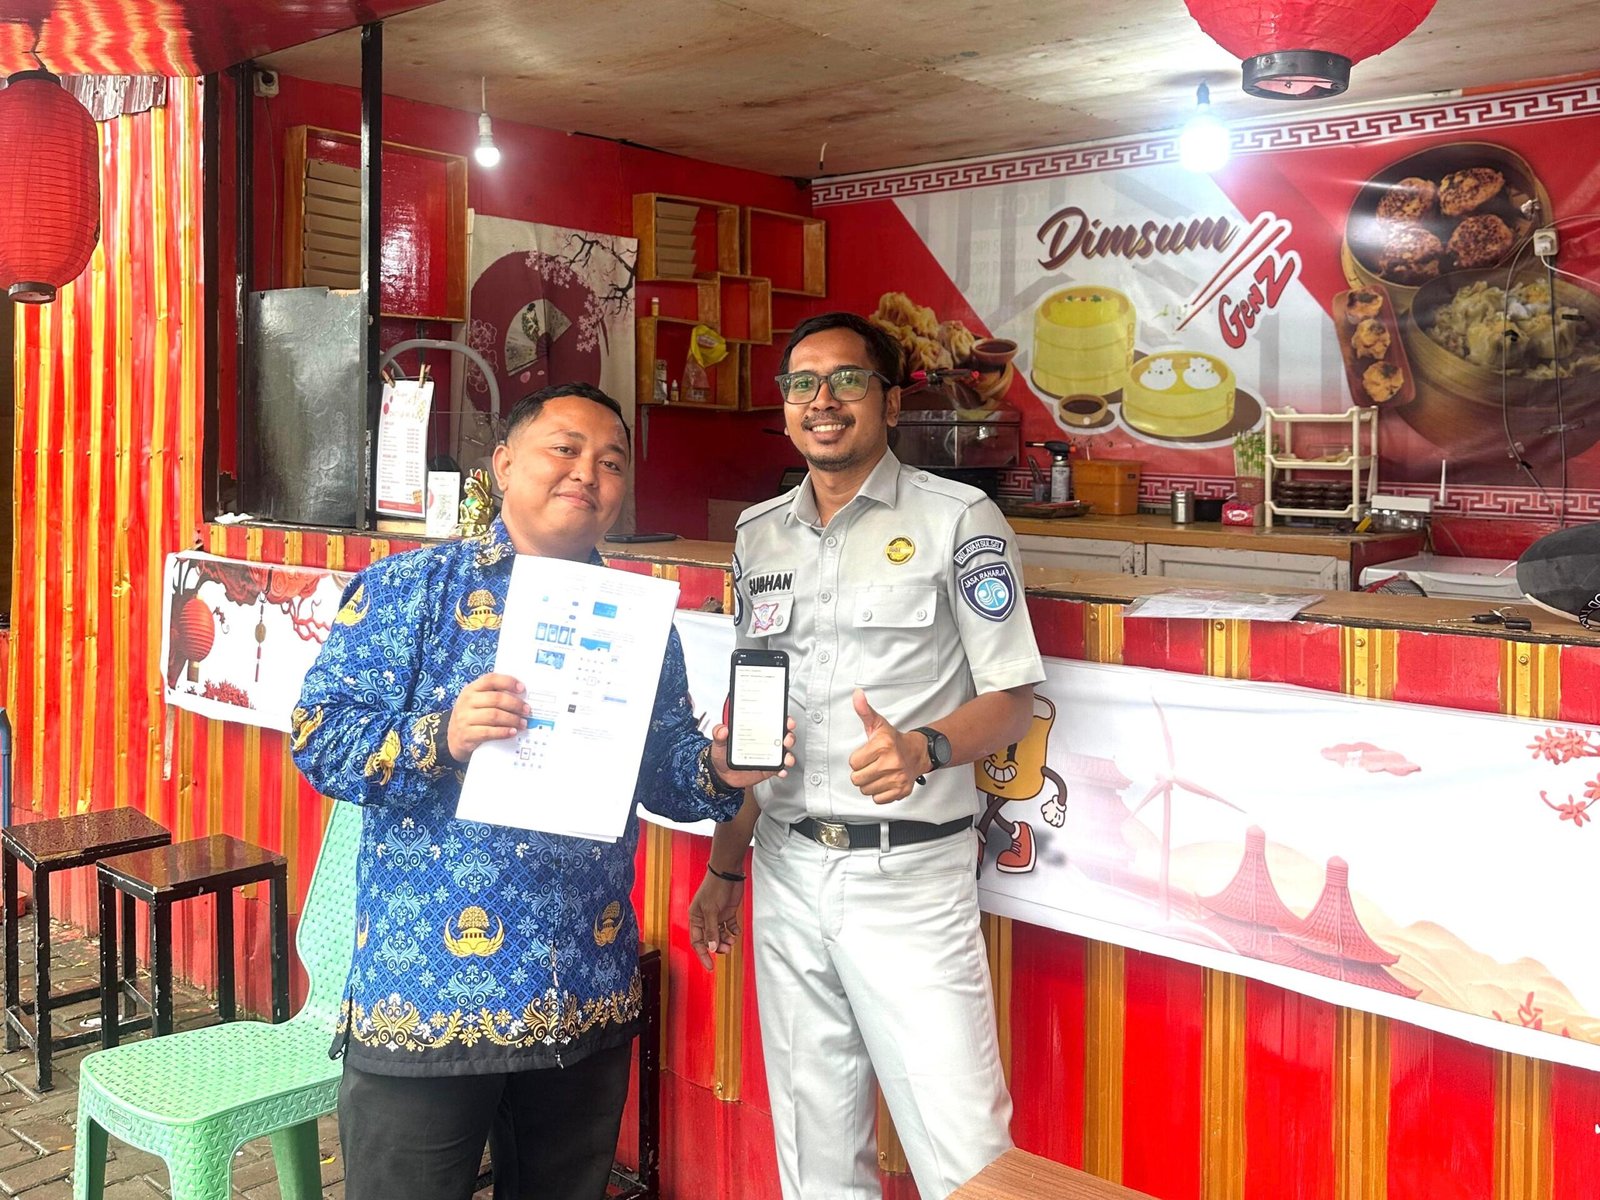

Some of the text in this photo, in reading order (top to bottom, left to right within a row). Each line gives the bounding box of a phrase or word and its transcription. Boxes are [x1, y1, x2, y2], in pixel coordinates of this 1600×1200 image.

[1037, 206, 1236, 271] Dimsum
[749, 573, 793, 596] SUBHAN
[964, 569, 1007, 588] JASA RAHARJA
